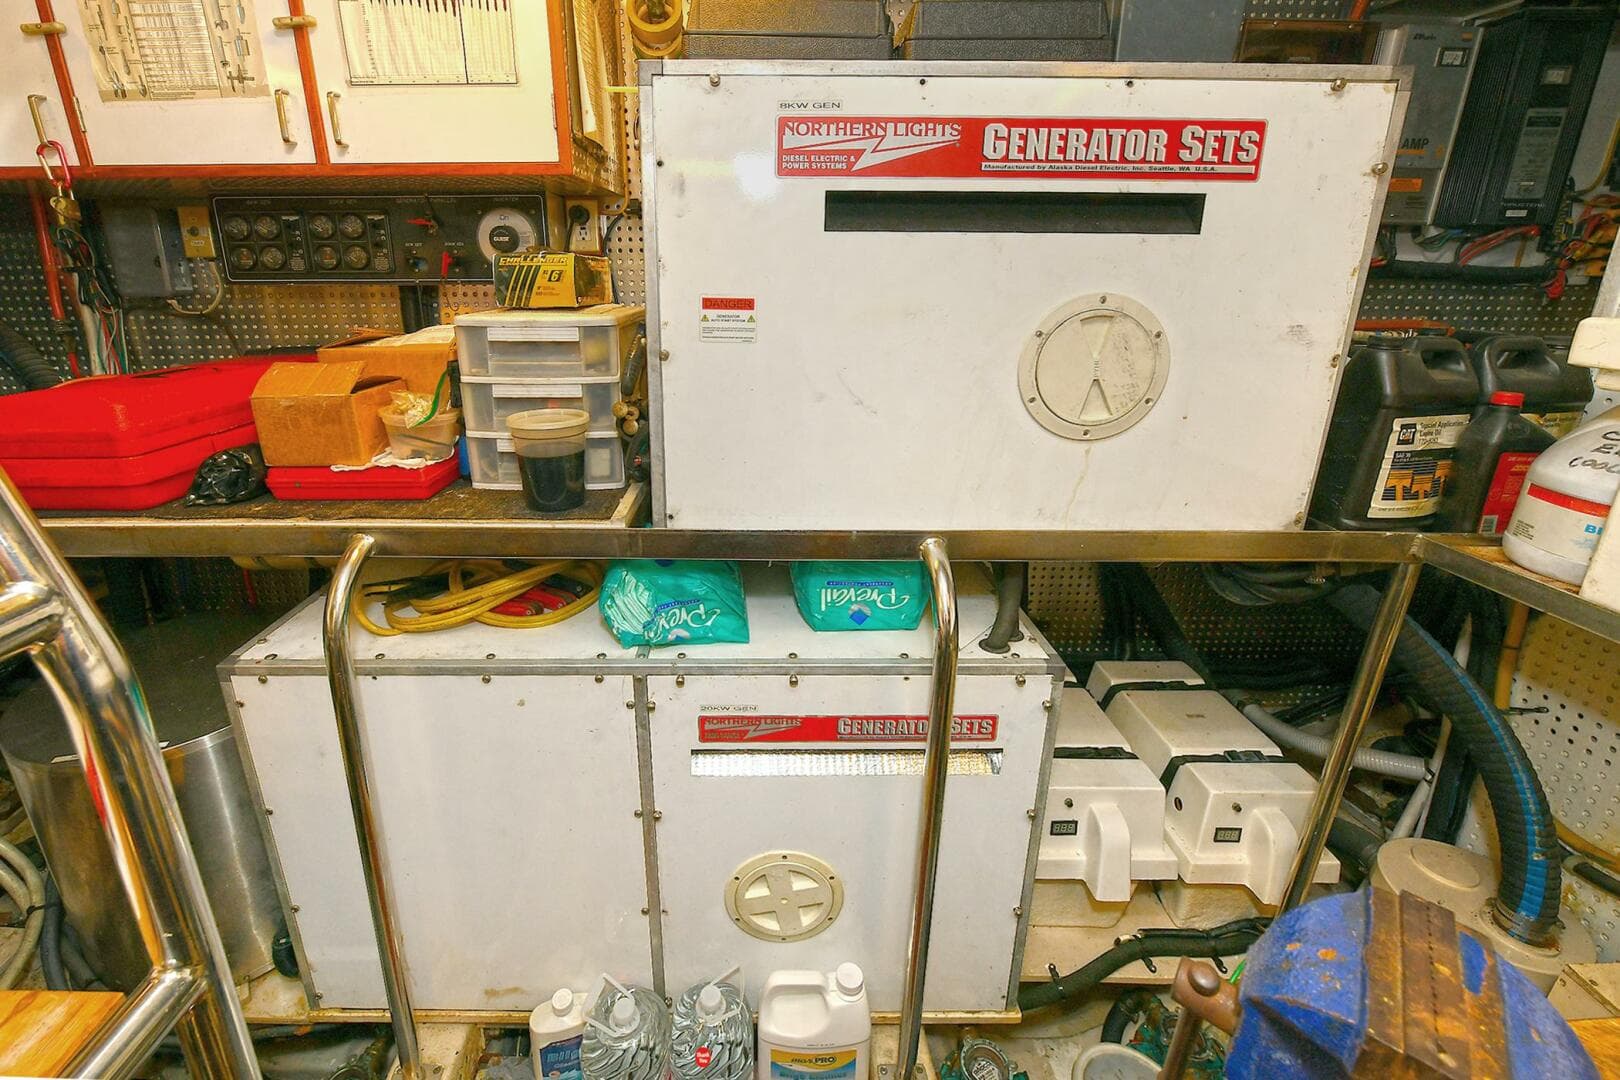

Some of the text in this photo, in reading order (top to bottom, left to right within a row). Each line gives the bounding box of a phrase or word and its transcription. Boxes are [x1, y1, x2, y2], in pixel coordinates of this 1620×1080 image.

[783, 121, 961, 138] NORTHERN LIGHTS
[982, 123, 1260, 164] GENERATOR SETS
[703, 299, 753, 309] DANGER
[1399, 428, 1415, 440] CAT
[821, 588, 910, 611] Prevail
[838, 717, 993, 735] GENERATO SETS
